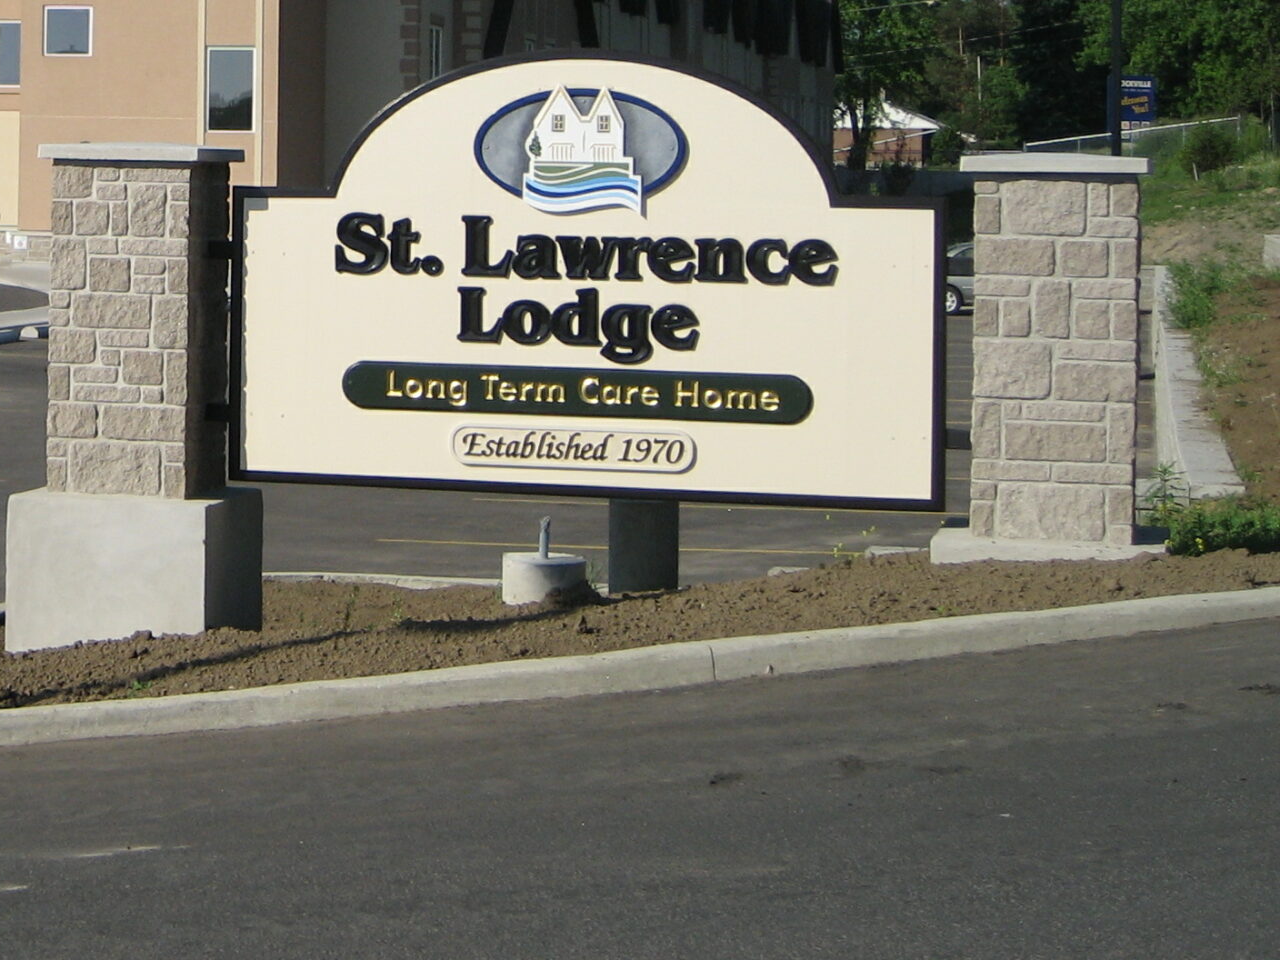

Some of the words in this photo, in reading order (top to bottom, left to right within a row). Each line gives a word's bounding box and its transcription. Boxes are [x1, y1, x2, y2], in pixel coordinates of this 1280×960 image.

[335, 211, 444, 276] St.
[461, 215, 838, 286] Lawrence
[457, 287, 699, 365] Lodge
[386, 370, 467, 406] Long
[481, 374, 566, 404] Term
[581, 377, 659, 407] Care
[675, 380, 780, 412] Home
[462, 431, 613, 462] Established
[618, 437, 685, 465] 1970
